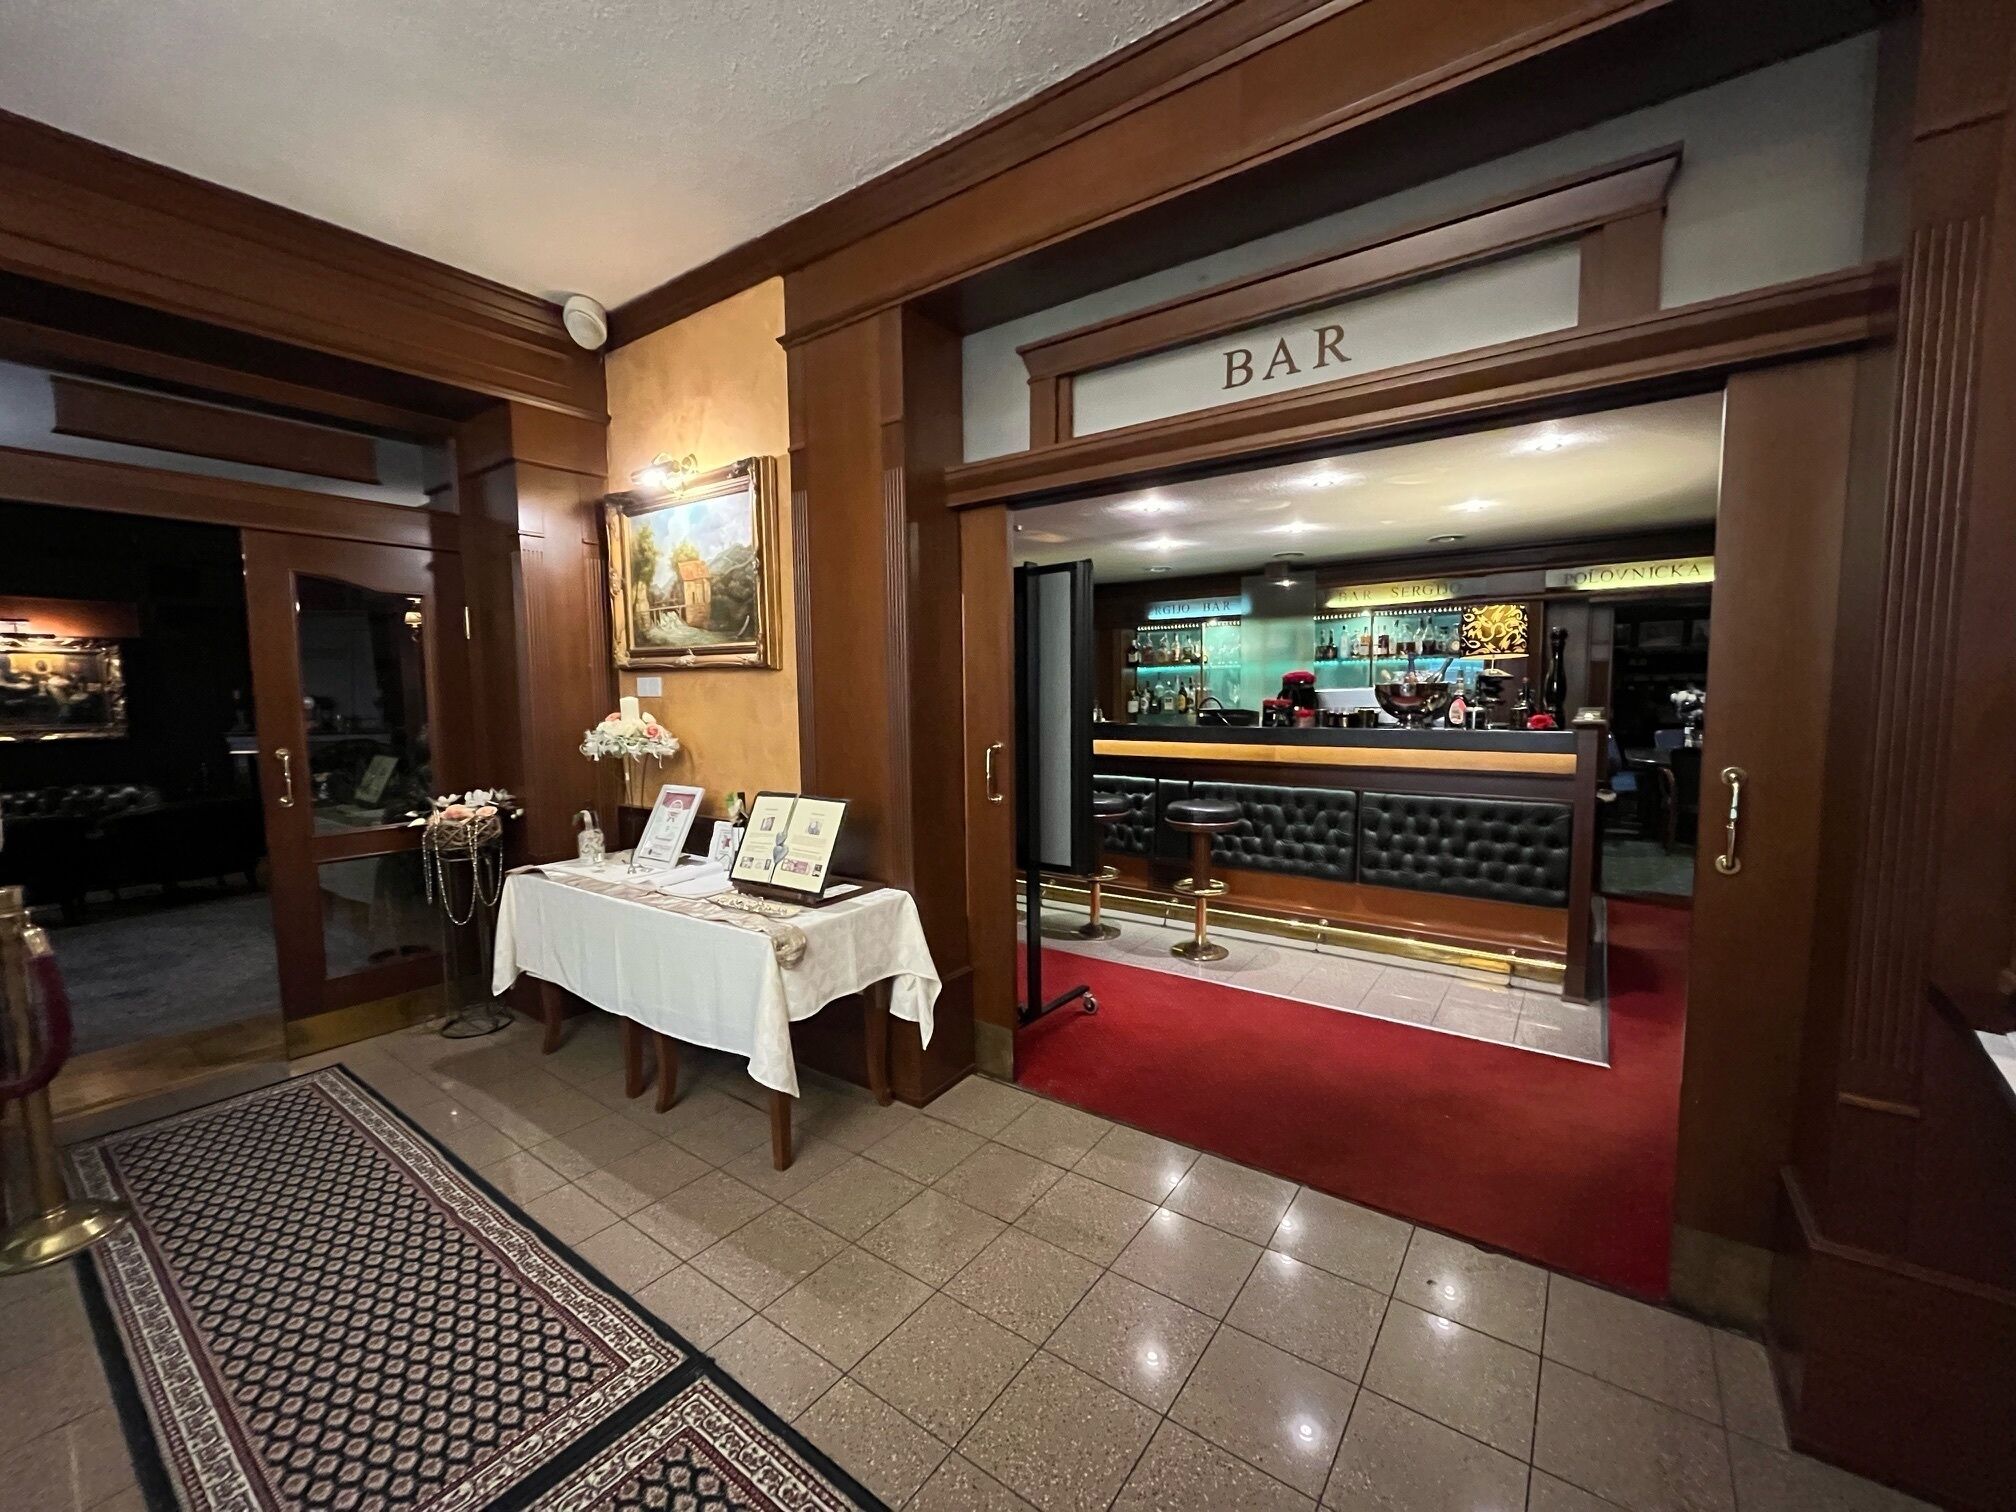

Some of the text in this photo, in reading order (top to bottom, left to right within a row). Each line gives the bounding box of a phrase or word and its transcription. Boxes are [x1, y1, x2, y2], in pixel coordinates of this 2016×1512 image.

[1221, 324, 1352, 390] BAR
[1337, 590, 1372, 602] BAR
[1151, 601, 1231, 615] RGIJO BAR
